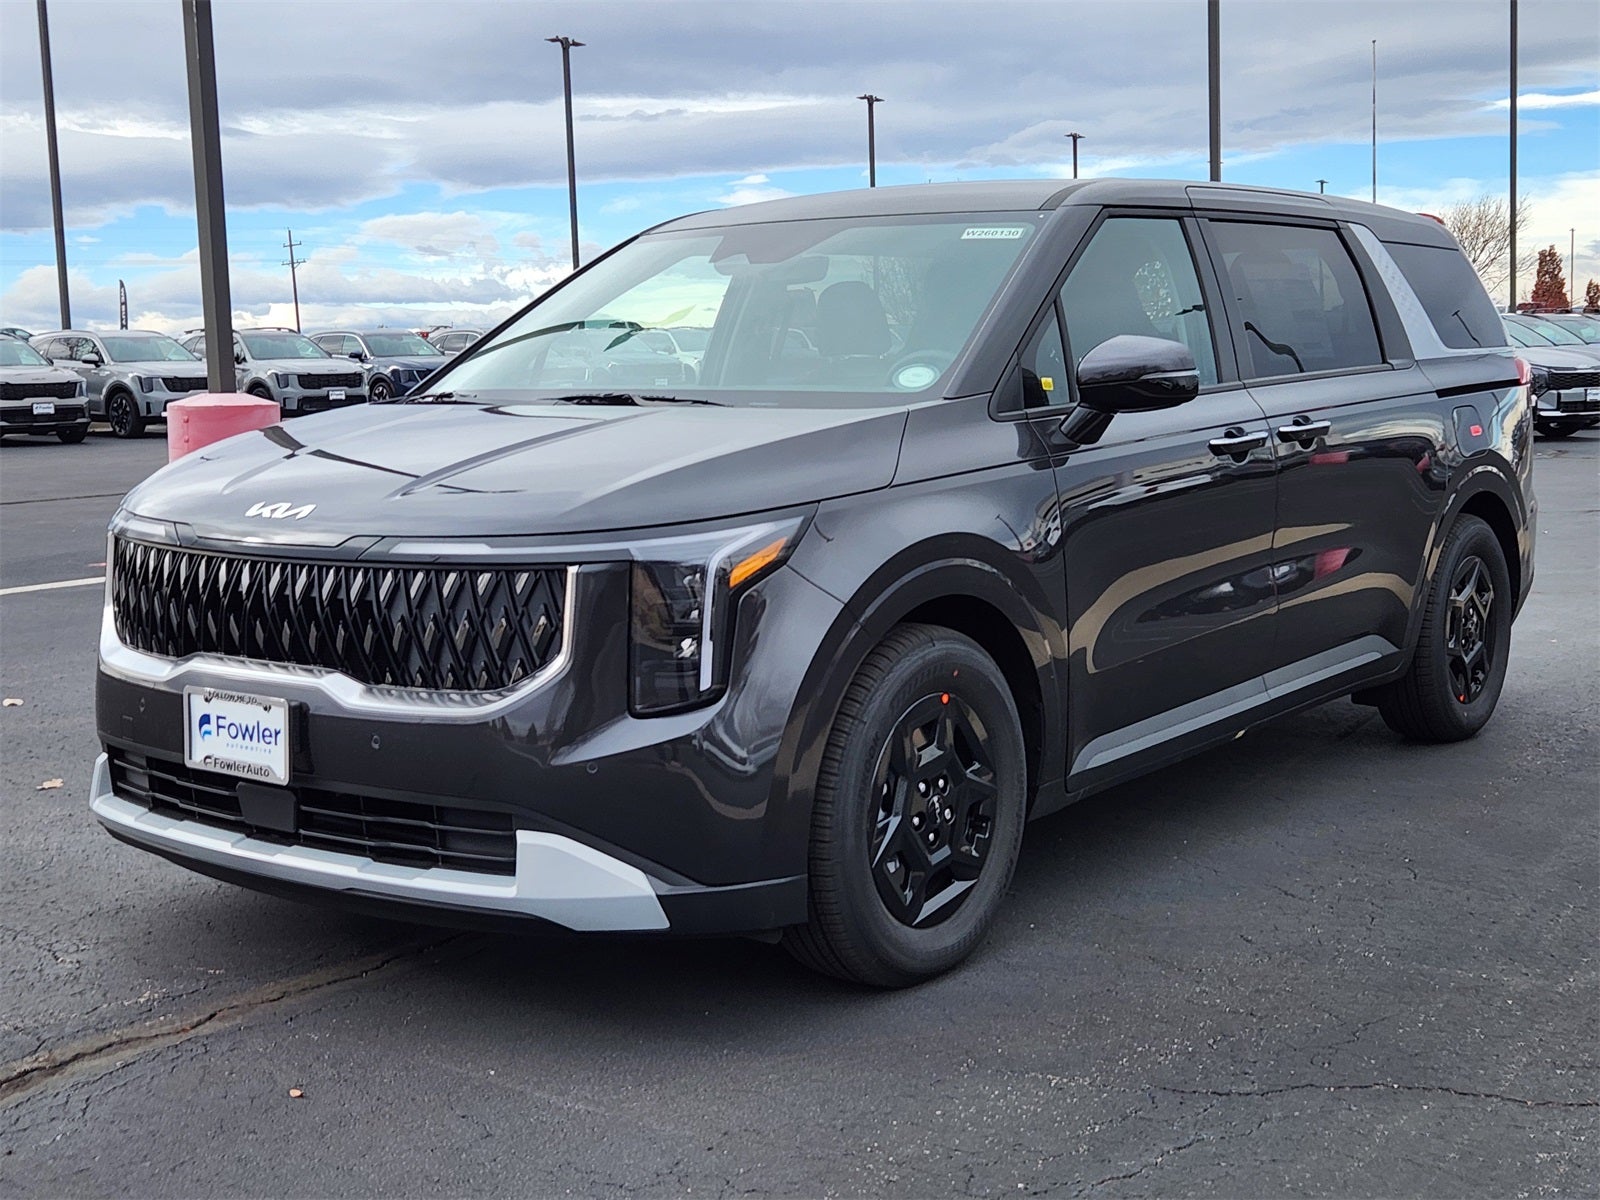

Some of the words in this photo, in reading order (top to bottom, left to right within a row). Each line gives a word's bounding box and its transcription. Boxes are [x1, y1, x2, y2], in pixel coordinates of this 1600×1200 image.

[966, 229, 1019, 237] W260130
[244, 501, 317, 520] KIA
[216, 715, 281, 746] Fowler
[213, 757, 270, 778] FowlerAuto
